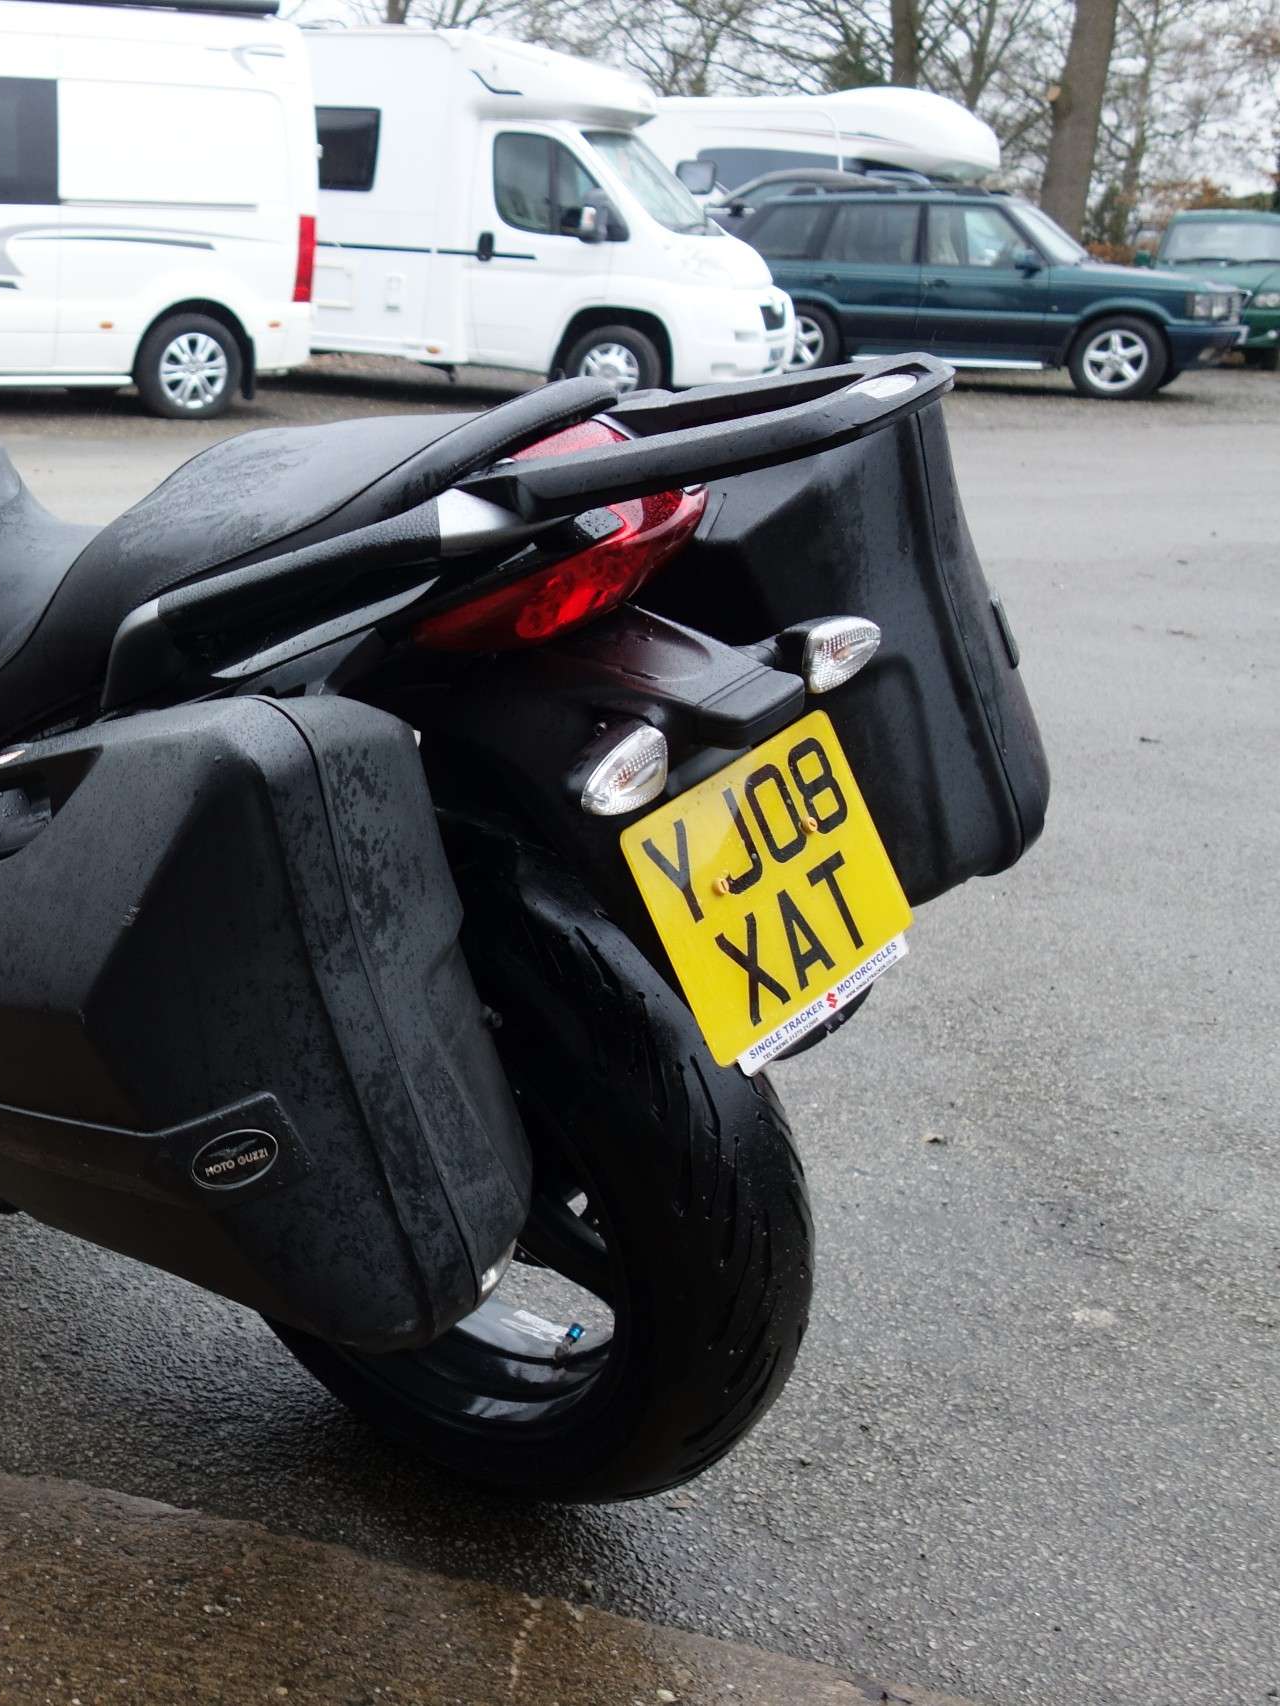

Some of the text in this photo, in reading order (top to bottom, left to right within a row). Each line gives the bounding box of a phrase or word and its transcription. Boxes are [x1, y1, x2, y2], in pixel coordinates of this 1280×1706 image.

[641, 737, 848, 923] YJ08
[714, 850, 864, 1026] XAT
[749, 942, 897, 1059] SINGLE TRACKER MOTORCYCLES
[205, 1147, 268, 1177] MOTO GUZZI
